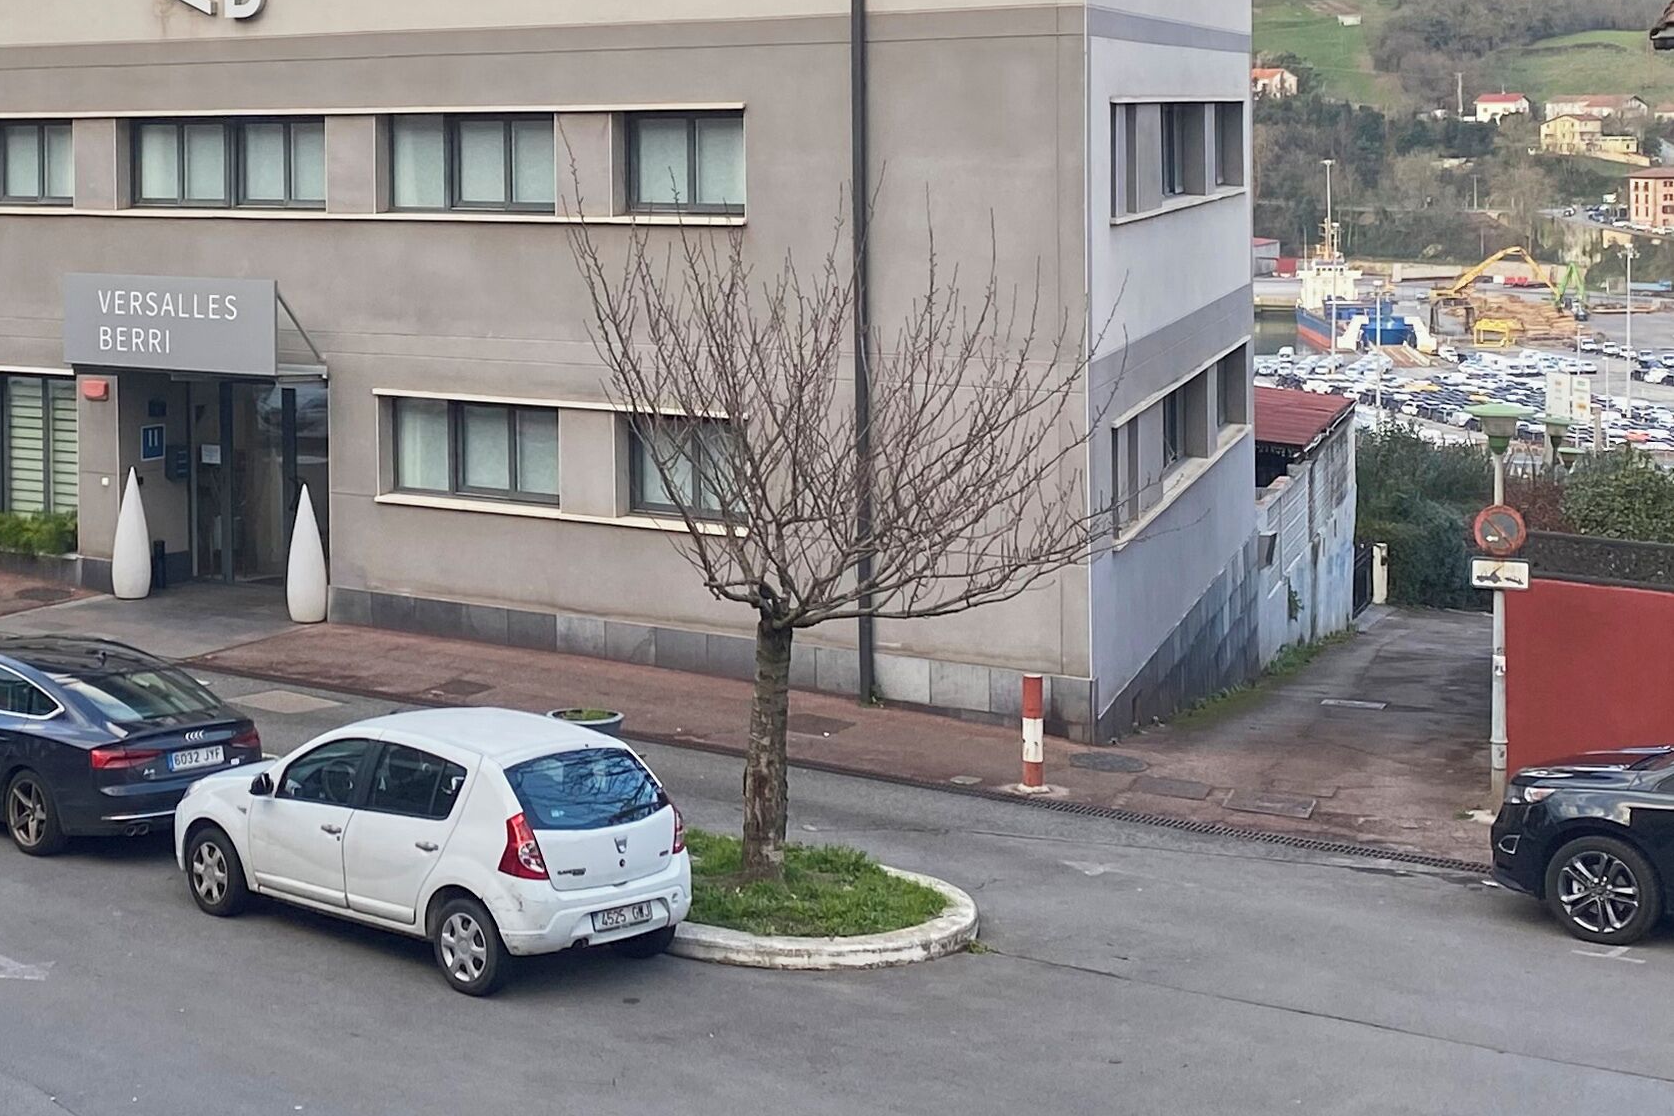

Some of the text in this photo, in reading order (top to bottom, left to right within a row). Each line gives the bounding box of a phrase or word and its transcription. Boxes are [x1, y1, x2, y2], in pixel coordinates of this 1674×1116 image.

[98, 289, 238, 321] VERSALLES
[99, 326, 170, 354] BERRI
[601, 908, 627, 926] 4525
